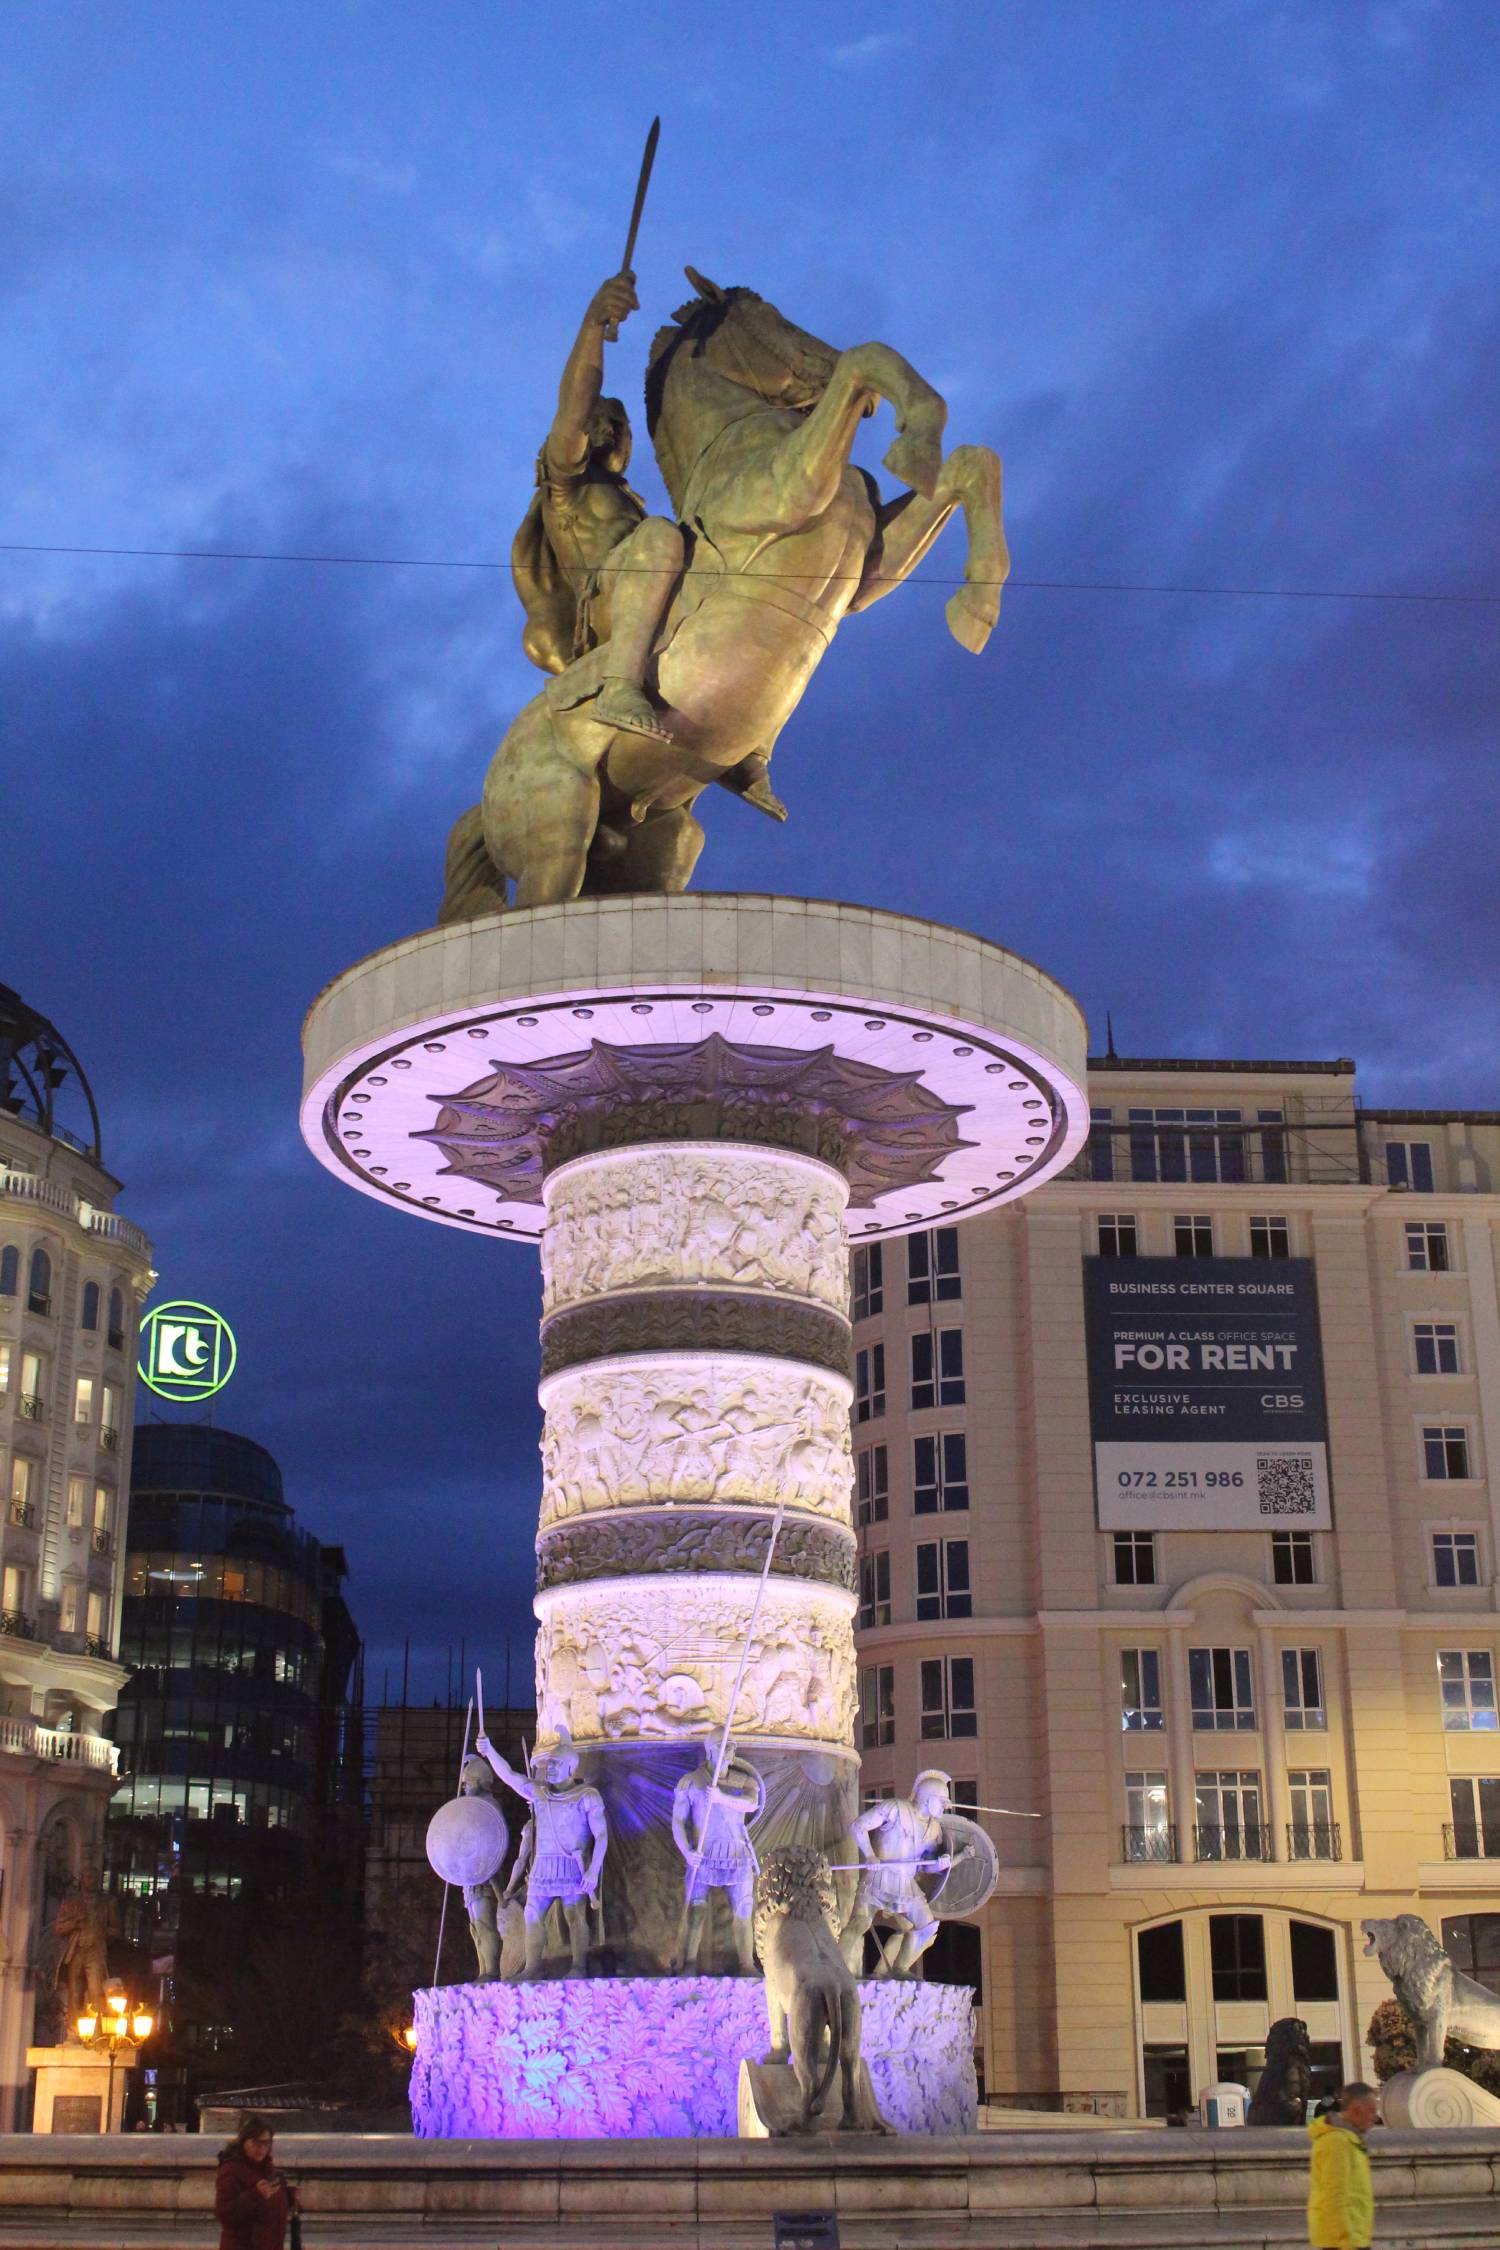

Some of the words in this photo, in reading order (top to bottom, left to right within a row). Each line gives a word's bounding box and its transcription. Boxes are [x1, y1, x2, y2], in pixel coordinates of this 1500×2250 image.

[1109, 1283, 1176, 1294] BUSINESS
[1180, 1284, 1234, 1295] CENTER
[1238, 1284, 1295, 1295] SQUARE
[1114, 1331, 1164, 1341] PREMIUM
[1168, 1332, 1176, 1341] A
[1179, 1332, 1215, 1341] CLASS
[1217, 1332, 1258, 1341] OFFICE
[1261, 1332, 1296, 1341] SPACE
[1114, 1344, 1191, 1370] FOR
[1201, 1344, 1298, 1370] RENT
[1114, 1394, 1190, 1403] EXCLUSIVE
[1261, 1395, 1304, 1408] CBS
[1115, 1405, 1174, 1415] LEASING
[1181, 1405, 1226, 1415] AGENT
[1118, 1471, 1158, 1487] 072
[1164, 1471, 1198, 1487] 251
[1205, 1471, 1244, 1487] 986
